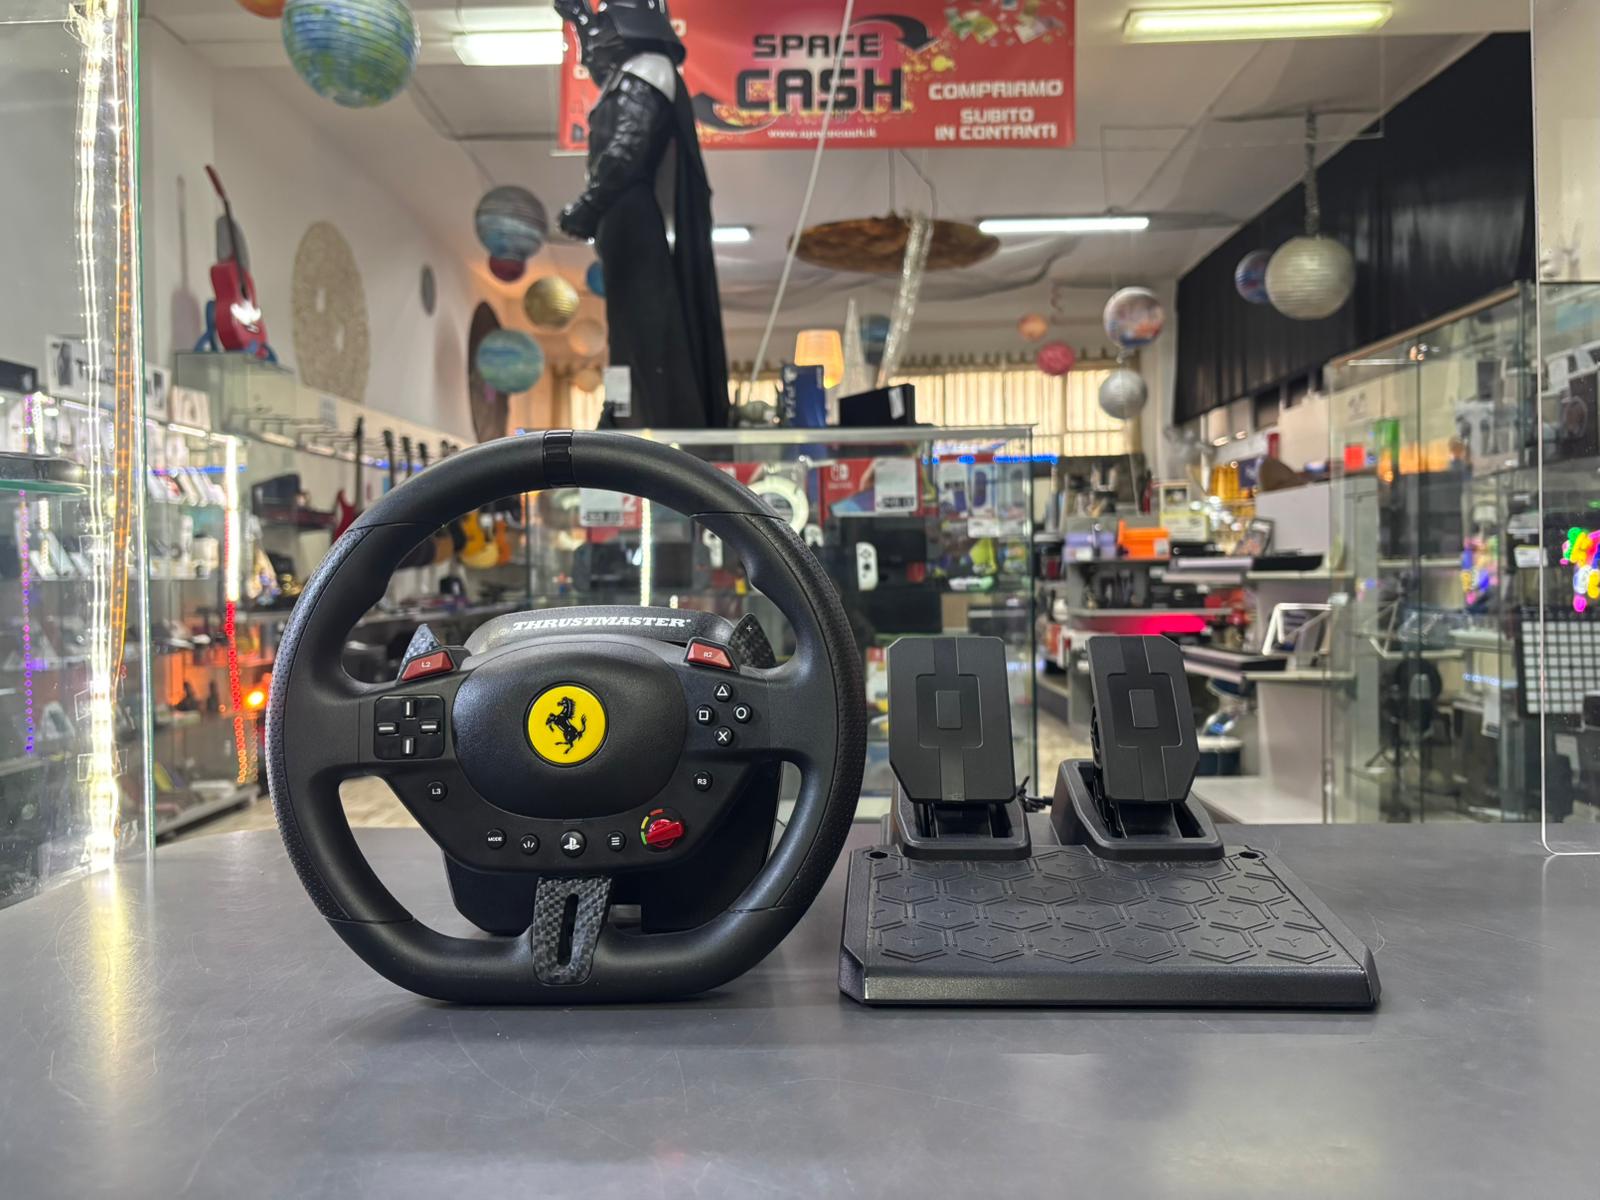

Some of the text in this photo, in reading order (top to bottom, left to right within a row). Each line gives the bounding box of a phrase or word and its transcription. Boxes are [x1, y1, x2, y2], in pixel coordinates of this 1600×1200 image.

[754, 34, 880, 58] SPACE
[737, 69, 903, 112] CASH
[928, 79, 1063, 100] COMPRIAMO
[960, 106, 1035, 124] SUBITO
[934, 123, 1058, 141] IN CONTANTI
[513, 616, 691, 631] THRUSTMASTER
